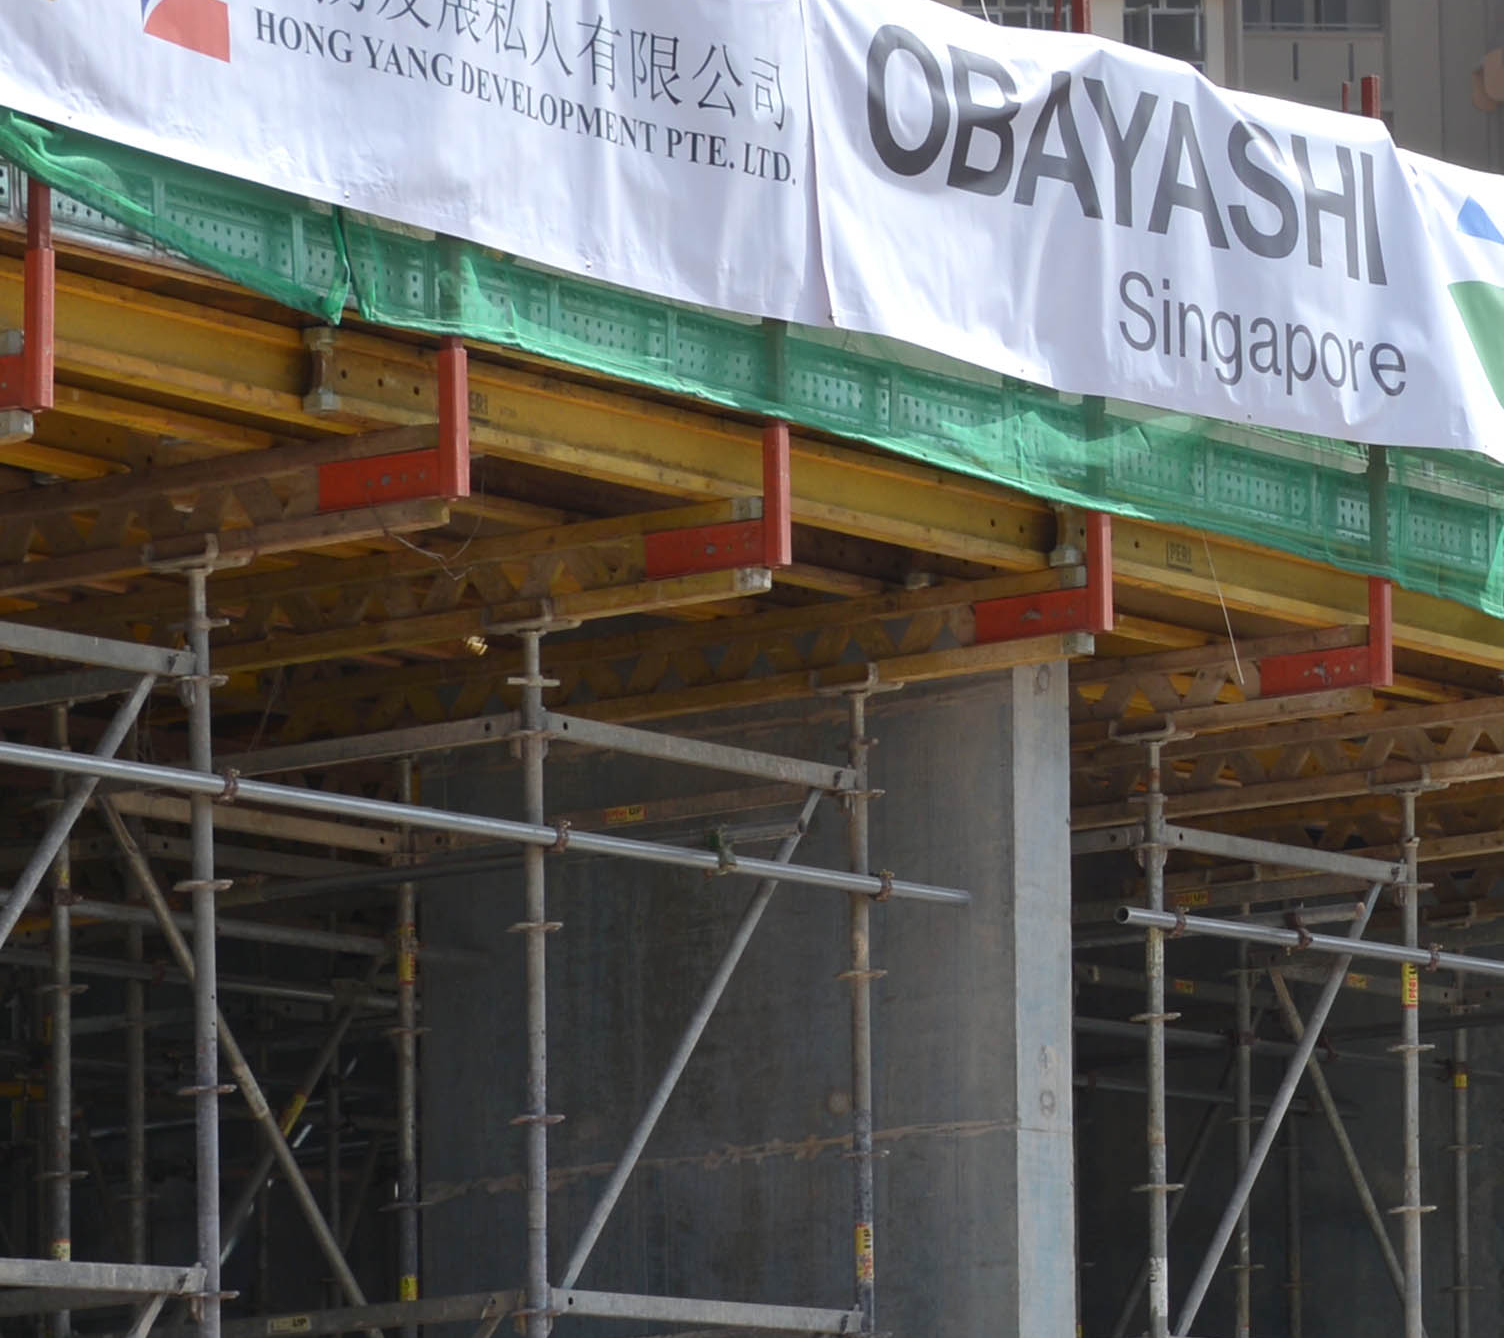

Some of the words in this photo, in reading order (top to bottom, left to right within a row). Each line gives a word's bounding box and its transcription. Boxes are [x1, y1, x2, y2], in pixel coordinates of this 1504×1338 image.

[254, 7, 353, 63] HONG
[362, 35, 454, 87] YANG
[460, 60, 657, 153] DEVELOPMENT
[666, 126, 735, 169] PTE.
[743, 142, 796, 186] LTD.
[867, 24, 1387, 286] OBAYASHI
[1118, 270, 1407, 397] Singapore
